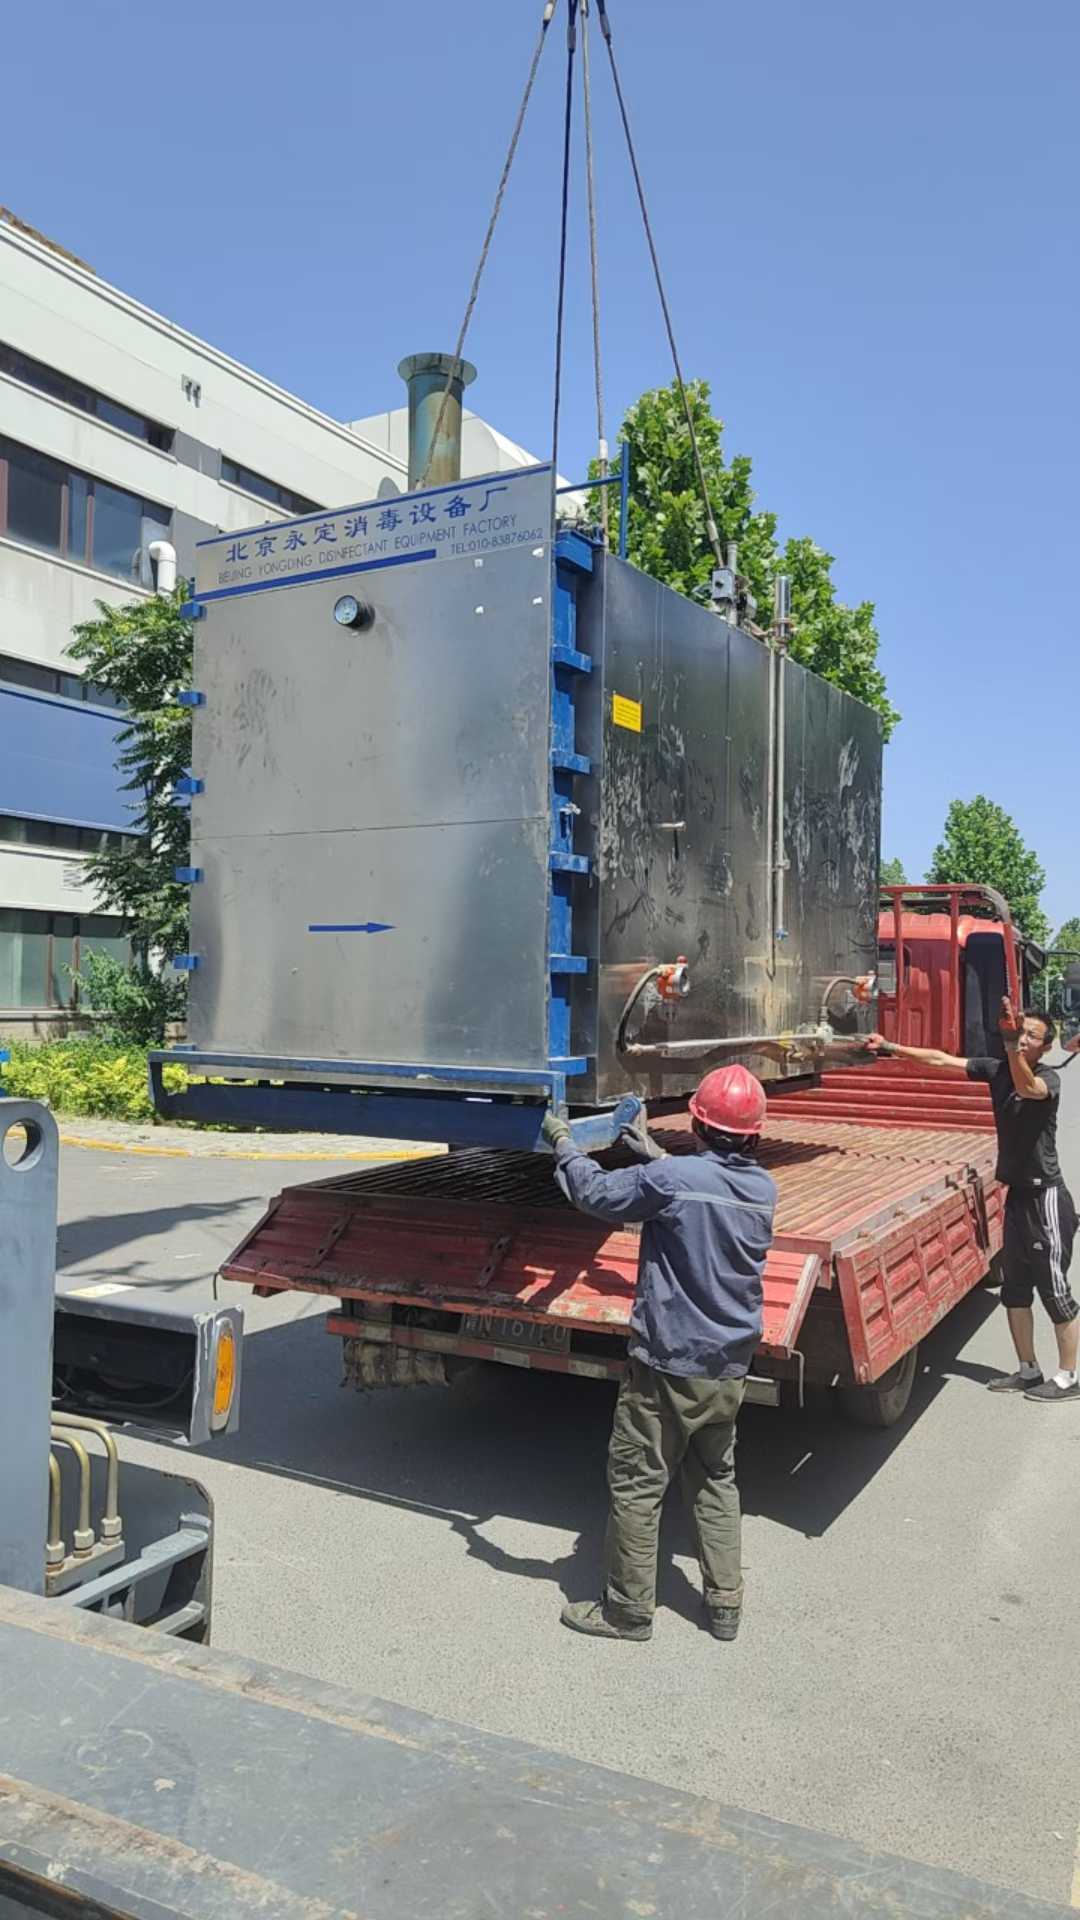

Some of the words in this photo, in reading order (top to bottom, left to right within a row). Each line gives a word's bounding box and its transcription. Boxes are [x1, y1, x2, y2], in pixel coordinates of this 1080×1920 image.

[218, 566, 252, 584] BEIJING
[258, 554, 312, 576] YONGDING
[319, 538, 389, 564] DISINFECTANT
[394, 526, 456, 550] EQUIPMENT
[463, 514, 517, 537] FACTORY
[225, 486, 508, 563] 北京永定消毒设备厂
